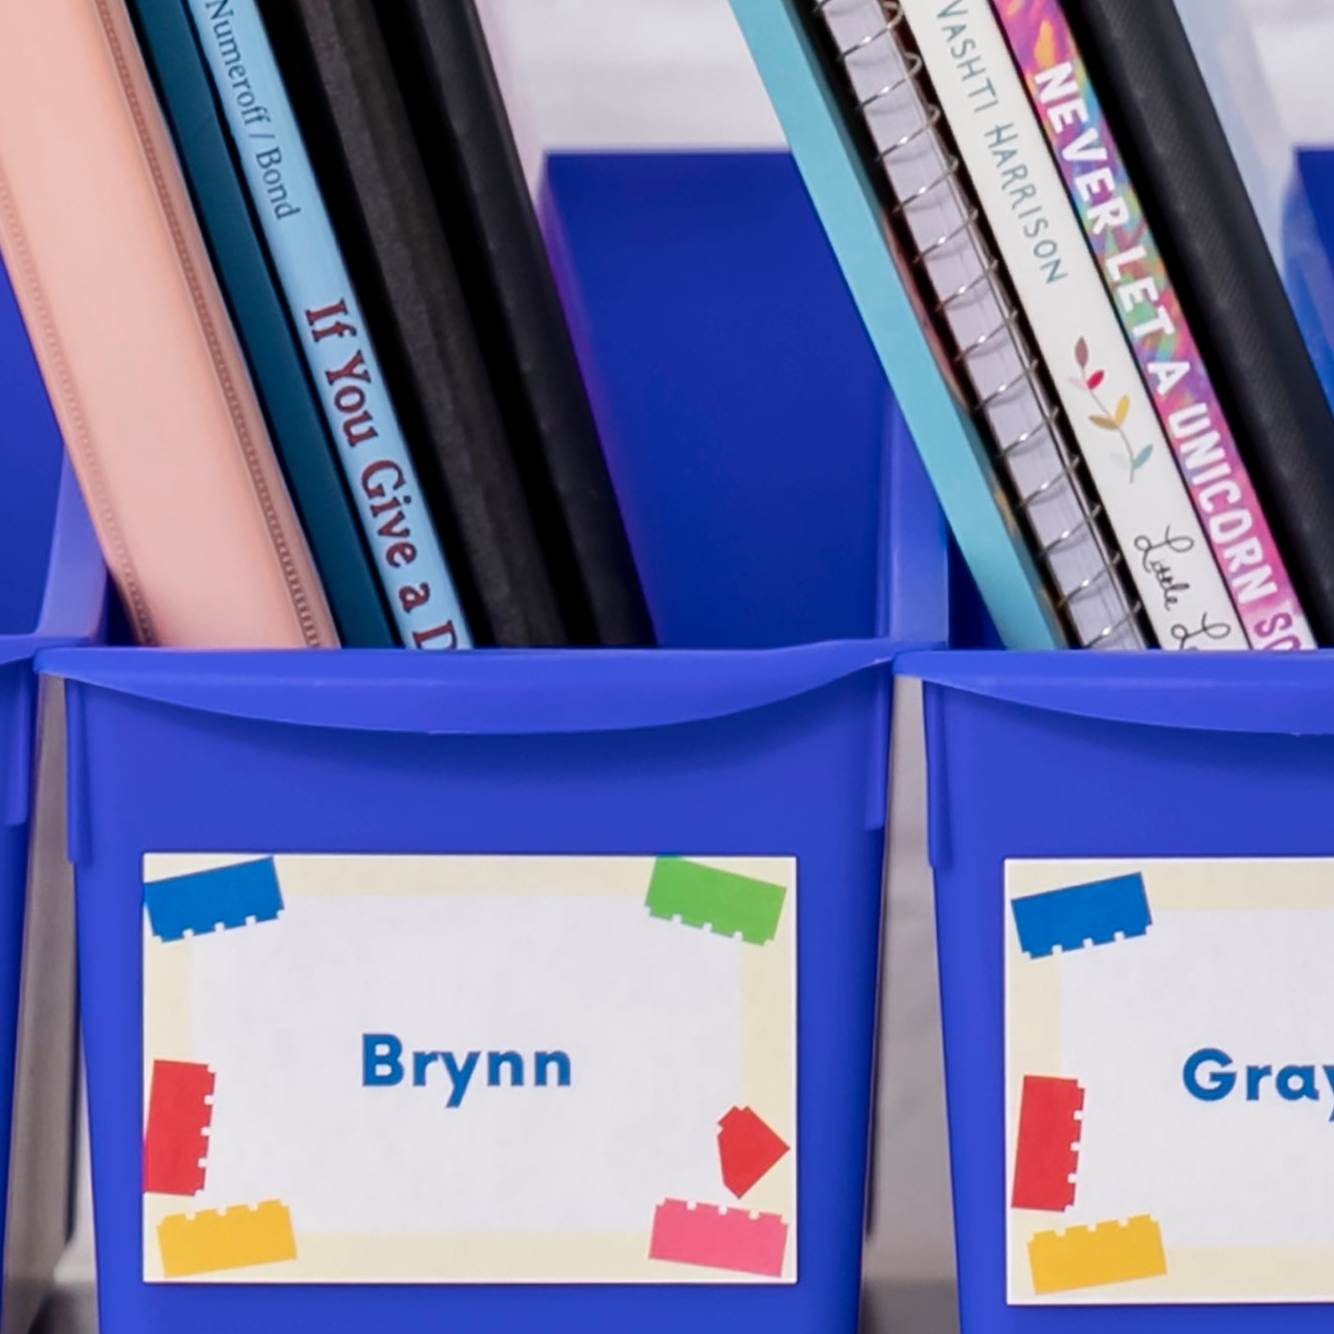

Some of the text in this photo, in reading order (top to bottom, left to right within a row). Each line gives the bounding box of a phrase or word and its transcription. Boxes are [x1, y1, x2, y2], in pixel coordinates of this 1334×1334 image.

[255, 147, 301, 220] Bond
[1034, 60, 1130, 237] NEVER
[984, 122, 1068, 284] HARRISON
[305, 297, 358, 343] If
[1104, 244, 1176, 339] LET
[324, 349, 379, 447] You
[1147, 361, 1190, 396] A
[360, 459, 418, 568] Give
[1167, 402, 1278, 604] UNICORN
[398, 581, 431, 614] a
[1134, 524, 1194, 611] Little
[362, 1033, 571, 1108] Brynn
